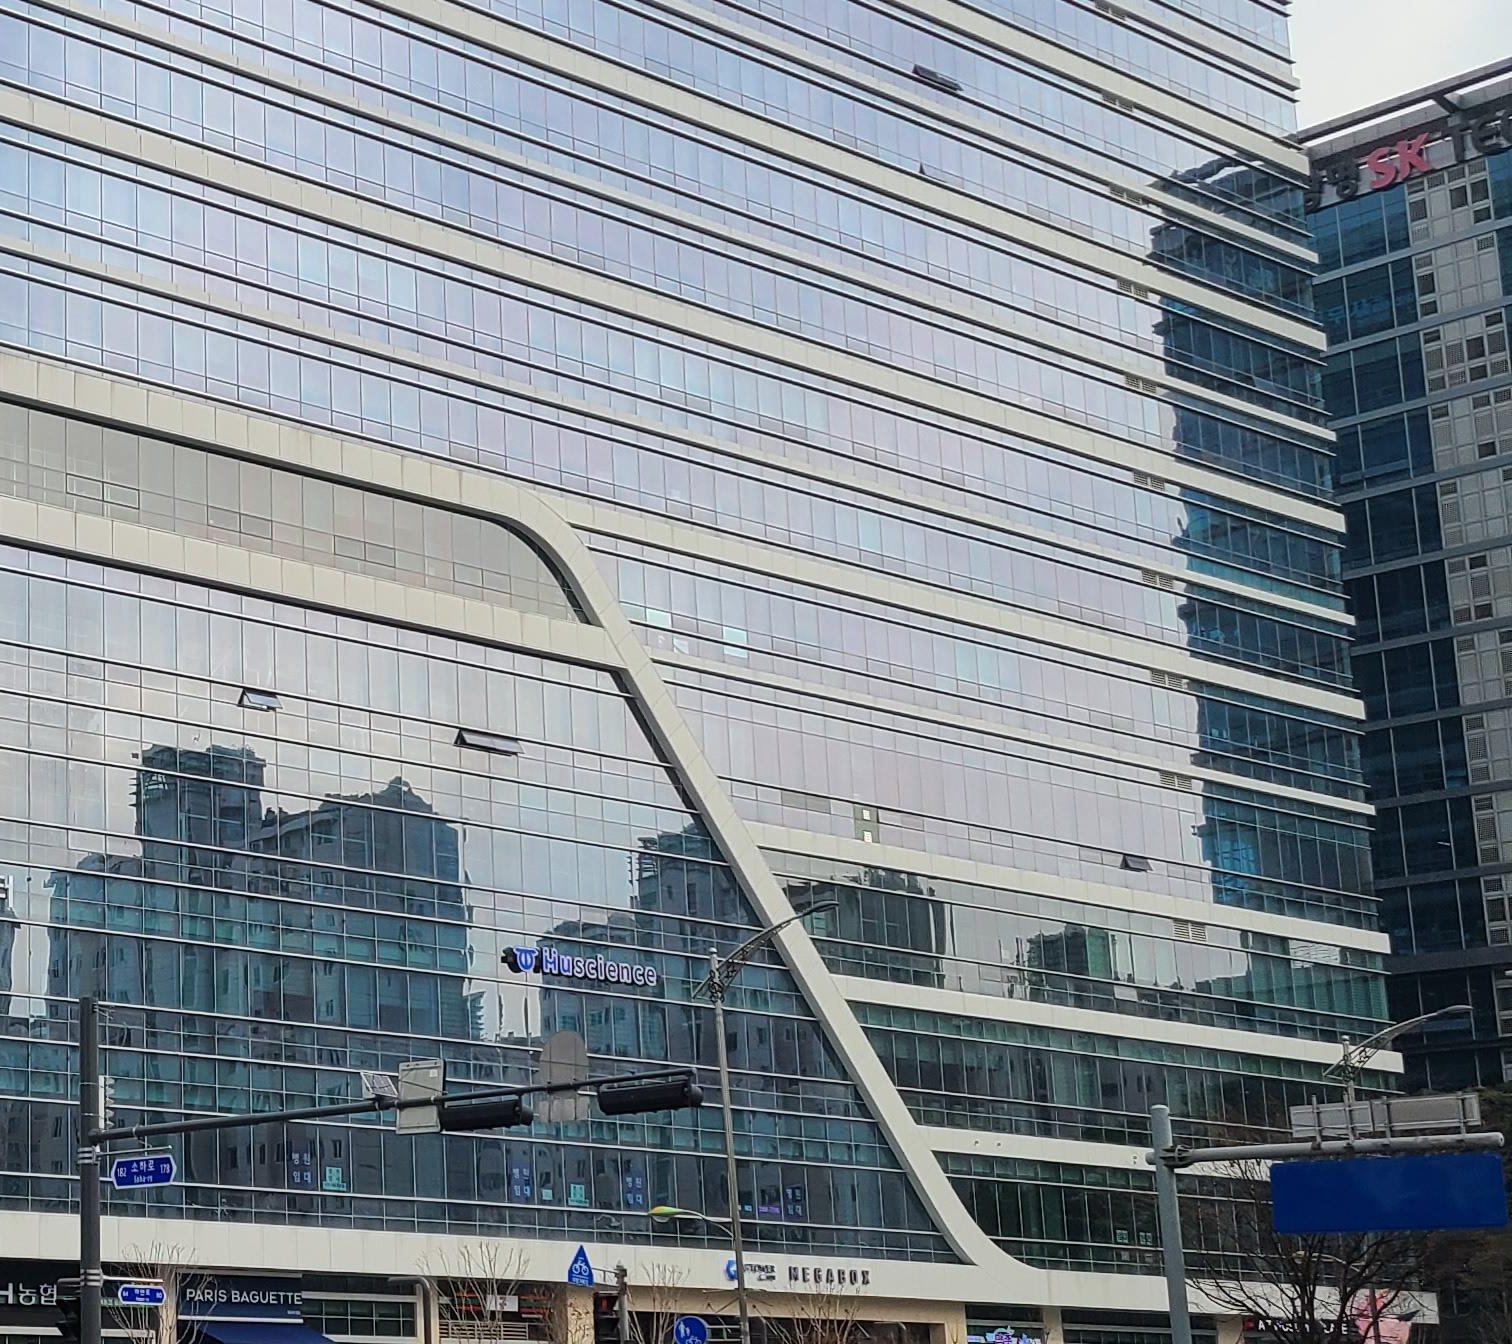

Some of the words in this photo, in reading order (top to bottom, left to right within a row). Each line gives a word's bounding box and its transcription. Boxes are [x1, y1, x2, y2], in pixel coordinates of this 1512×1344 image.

[1368, 132, 1432, 190] SK
[542, 946, 657, 987] Huscience
[117, 1167, 127, 1178] 182
[130, 1160, 156, 1173] 소하로
[160, 1164, 171, 1174] 178
[293, 1171, 312, 1183] 임대
[787, 1265, 872, 1286] MEGABOX
[18, 1282, 57, 1306] 농협
[186, 1289, 228, 1303] PARIS
[231, 1290, 303, 1305] BAGUETTE
